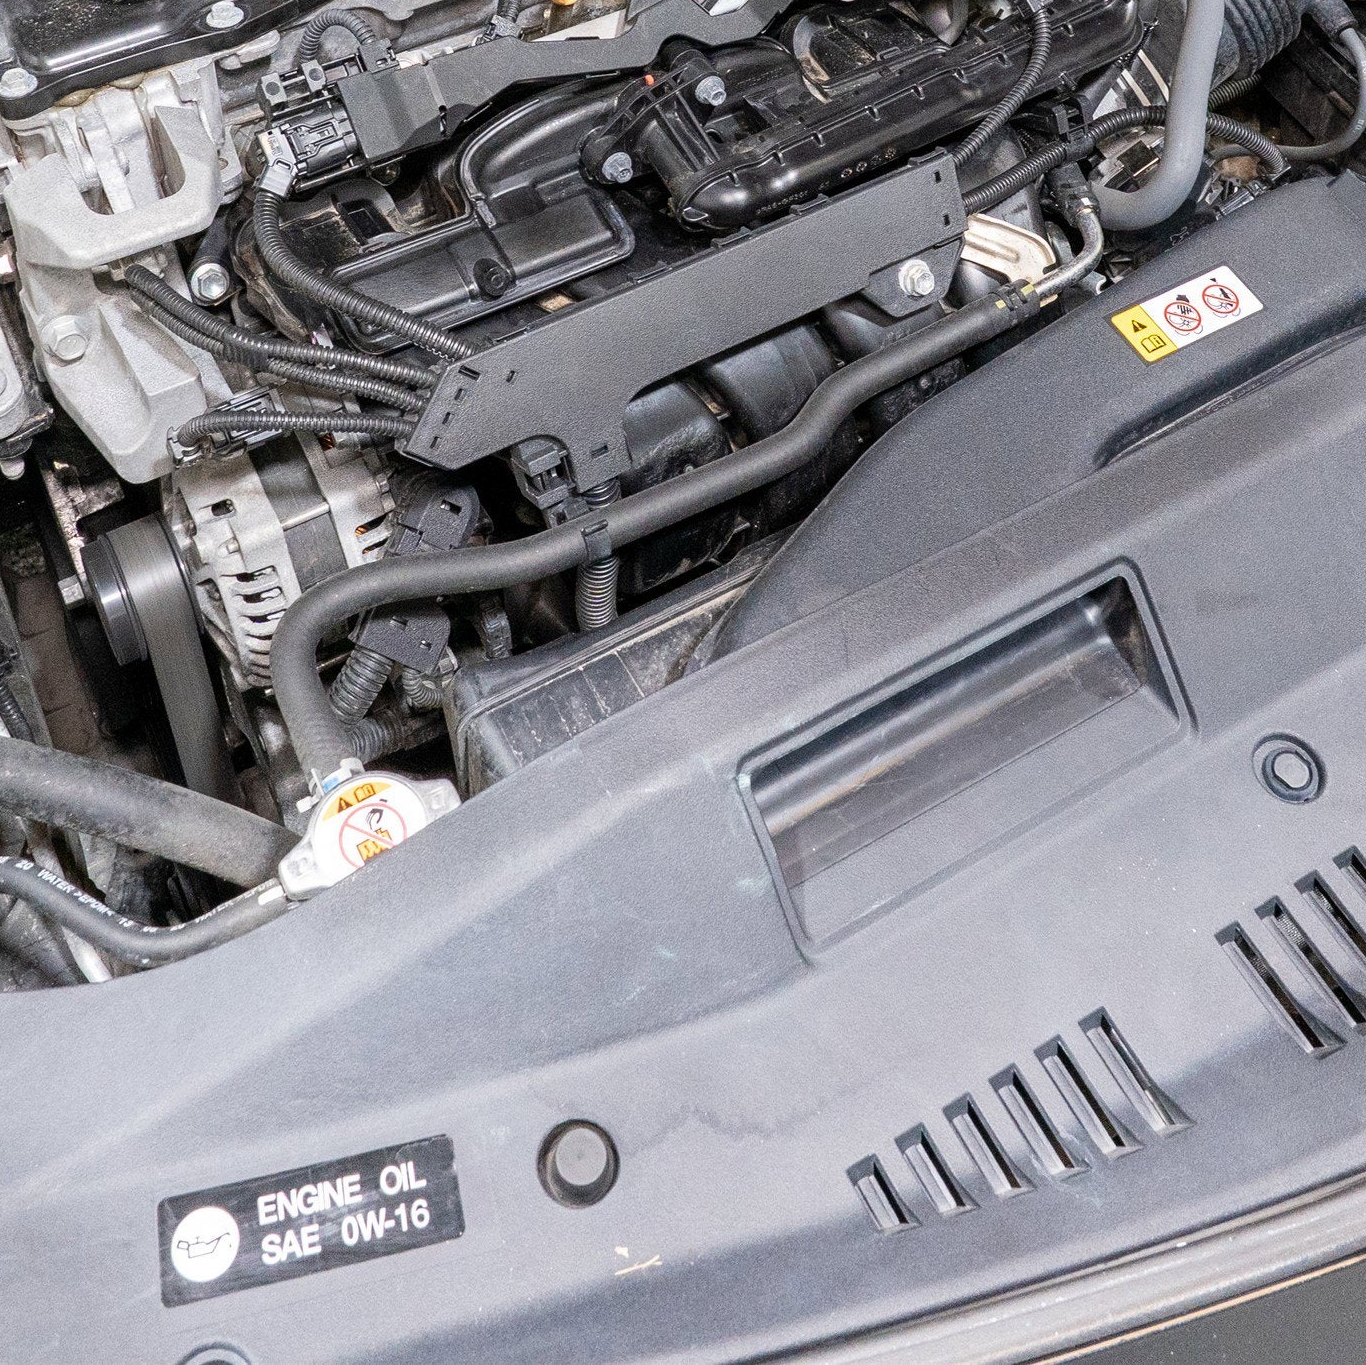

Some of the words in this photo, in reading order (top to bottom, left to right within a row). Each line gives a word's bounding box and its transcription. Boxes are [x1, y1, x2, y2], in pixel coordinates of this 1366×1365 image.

[15, 858, 34, 871] 20
[37, 868, 75, 895] WATER
[257, 1174, 363, 1225] ENGINE
[379, 1161, 427, 1196] OIL
[261, 1224, 322, 1266] SAE
[341, 1200, 431, 1247] 0W-16
